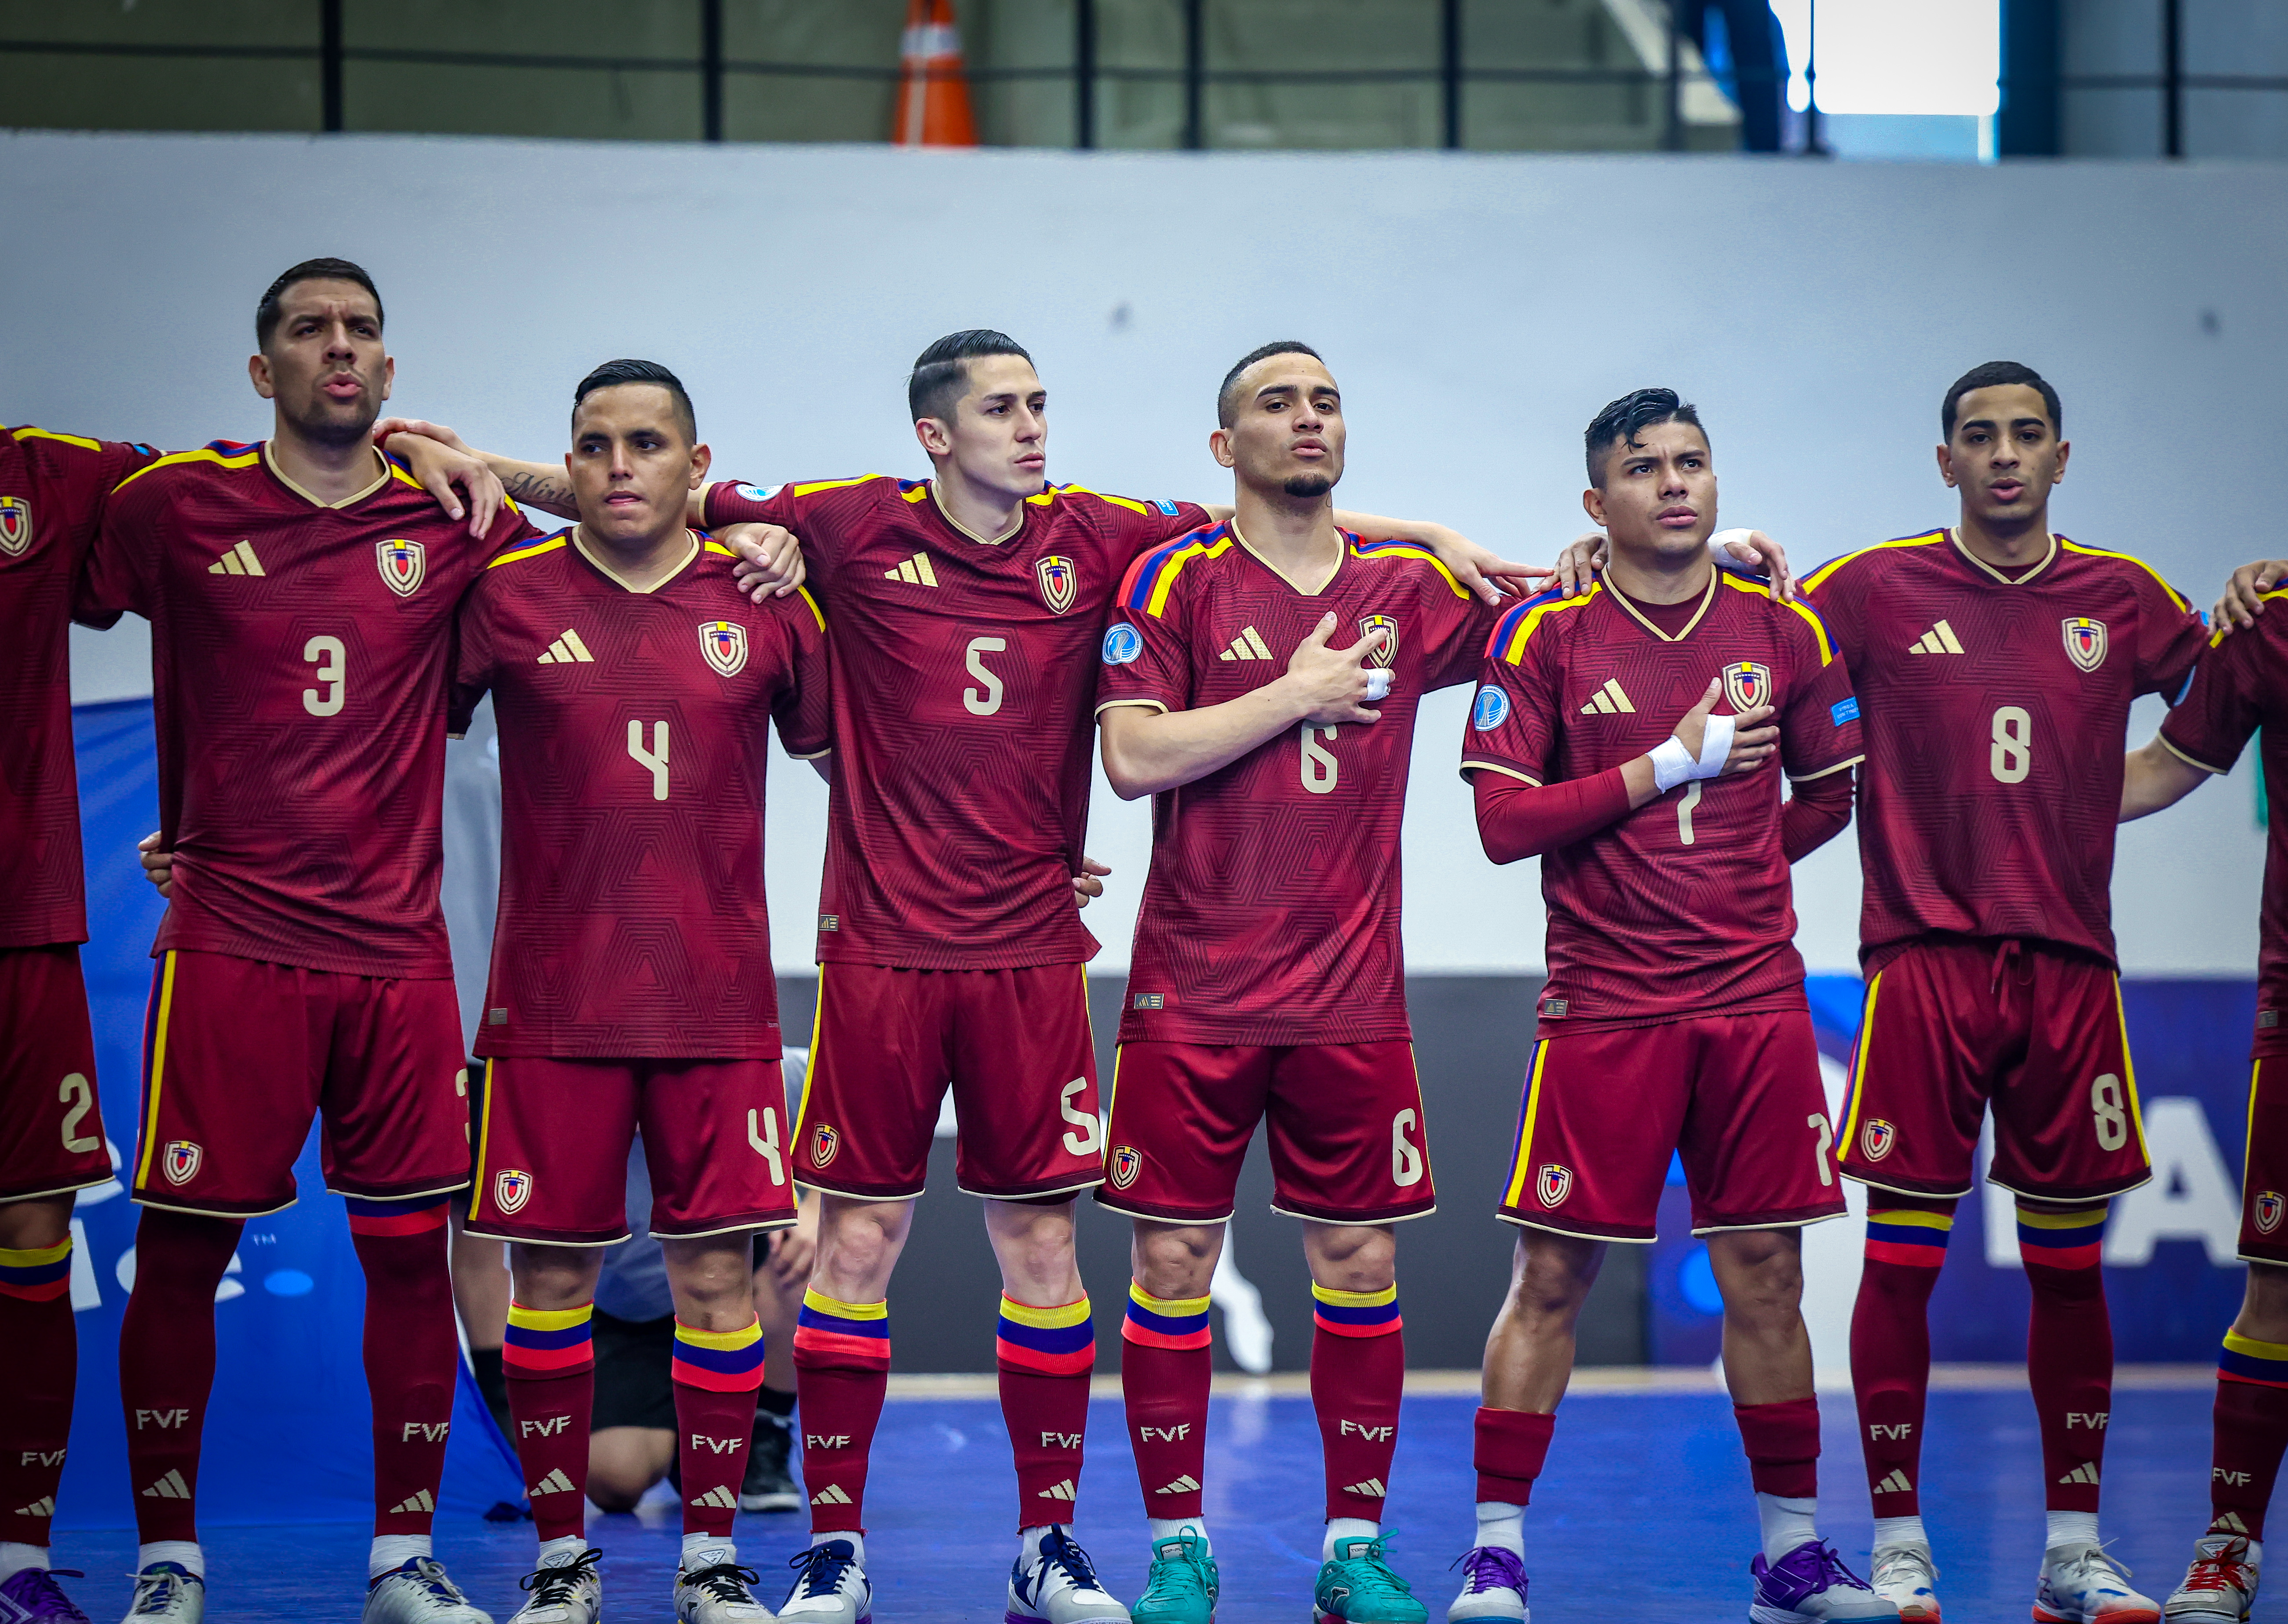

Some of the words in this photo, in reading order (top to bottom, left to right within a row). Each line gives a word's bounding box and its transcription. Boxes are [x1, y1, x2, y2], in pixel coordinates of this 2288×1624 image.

[303, 635, 346, 716] 3
[963, 637, 1006, 716] 5
[627, 719, 669, 801] 4
[1300, 722, 1339, 794] 6
[1990, 706, 2031, 784] 8
[59, 1073, 100, 1153] 2
[1060, 1076, 1101, 1156] 5
[2091, 1073, 2128, 1151] 8
[748, 1107, 785, 1186] 4
[1392, 1108, 1423, 1187] 6
[1807, 1113, 1833, 1186] 7
[136, 1409, 189, 1430] FVF
[403, 1422, 449, 1442] FVF
[521, 1416, 571, 1438] FVF
[807, 1434, 850, 1449] FVF
[1042, 1431, 1082, 1449] FVF
[1140, 1423, 1190, 1442] FVF
[1341, 1419, 1393, 1442] FVF
[1870, 1423, 1912, 1441] FVF
[2067, 1412, 2108, 1430] FVF
[692, 1434, 742, 1454] FVF
[2213, 1467, 2252, 1487] FVF
